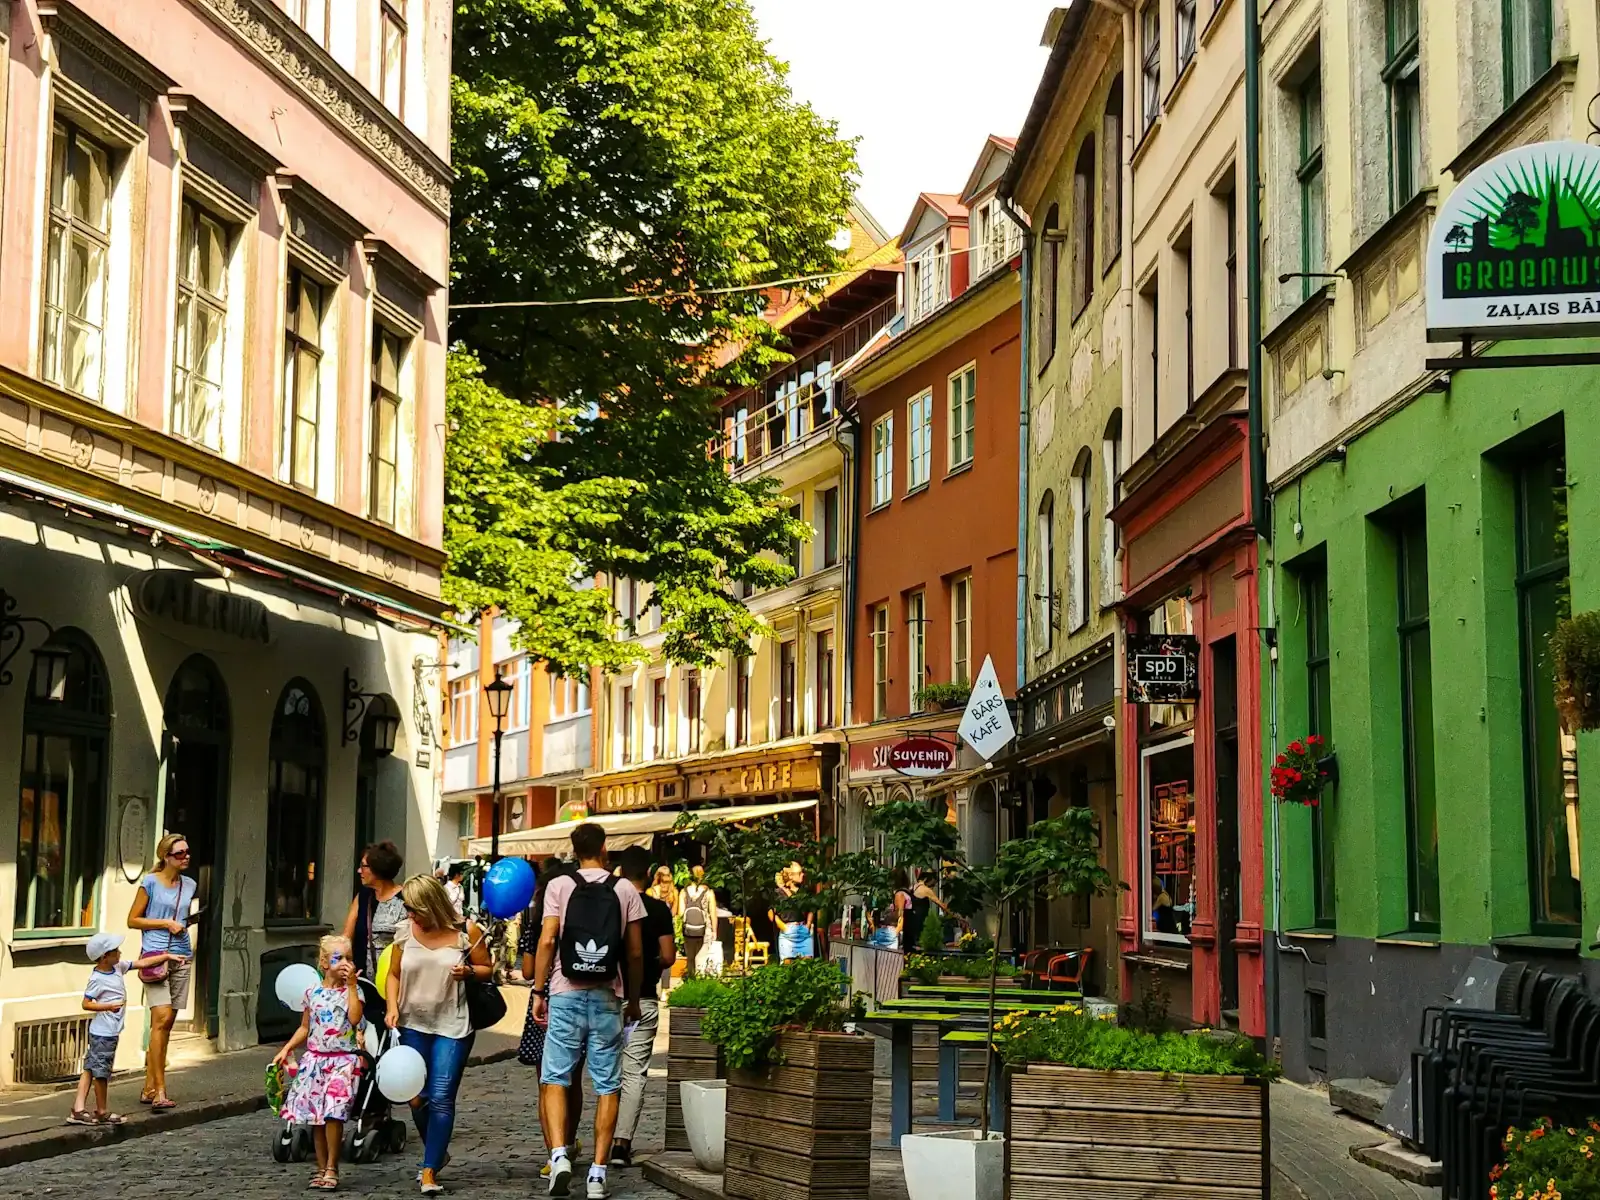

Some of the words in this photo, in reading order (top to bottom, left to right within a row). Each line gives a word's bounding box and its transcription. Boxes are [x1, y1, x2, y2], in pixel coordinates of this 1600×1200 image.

[1486, 302, 1560, 320] ZAĻAIS
[1145, 657, 1177, 676] spb
[971, 694, 1003, 721] BĀRS
[969, 715, 1002, 744] KAFĒ
[893, 749, 949, 761] SUVENĪRI
[607, 785, 647, 808] CUBA
[572, 962, 607, 973] adidas
